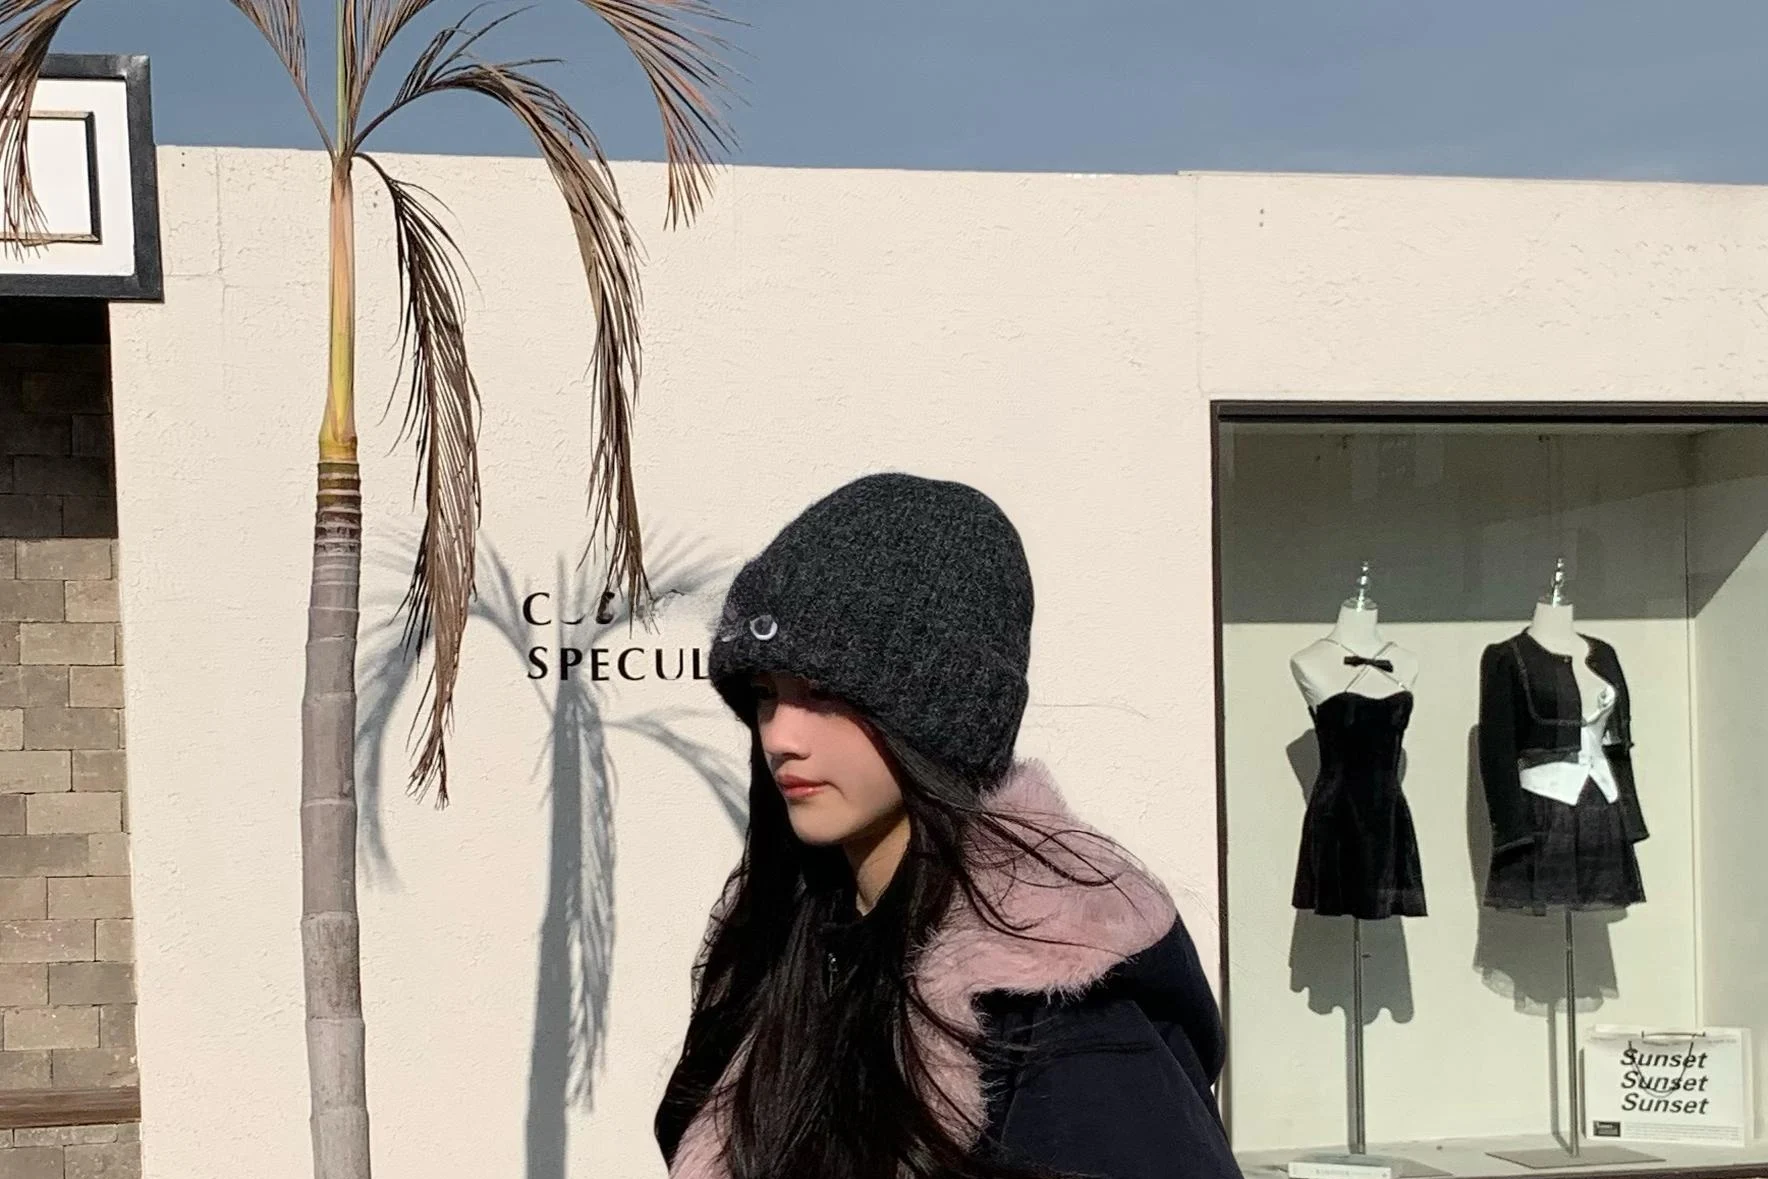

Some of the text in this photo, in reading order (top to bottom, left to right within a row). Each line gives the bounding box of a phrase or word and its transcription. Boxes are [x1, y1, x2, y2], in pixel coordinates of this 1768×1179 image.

[528, 646, 710, 681] SPECUL
[1620, 1047, 1708, 1069] Sunset
[1621, 1069, 1708, 1092] Sunset
[1621, 1092, 1709, 1115] Sunset
